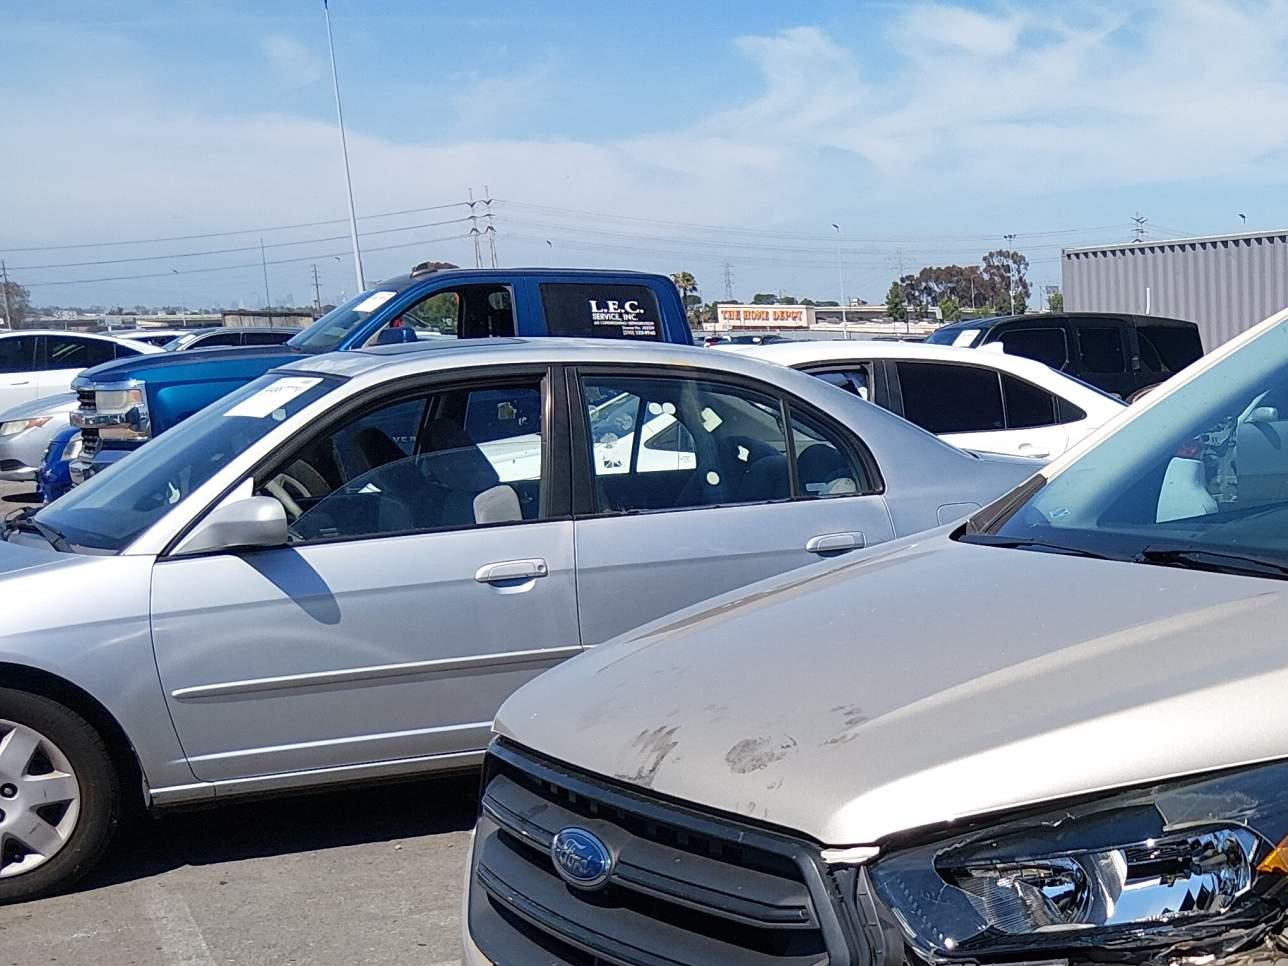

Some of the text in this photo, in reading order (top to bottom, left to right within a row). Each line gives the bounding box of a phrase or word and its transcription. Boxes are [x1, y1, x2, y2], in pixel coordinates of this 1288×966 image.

[589, 300, 645, 314] L.E.C.
[623, 313, 639, 321] INC.
[720, 310, 742, 321] THE
[772, 310, 803, 321] DEPOT
[555, 838, 593, 874] Ford
